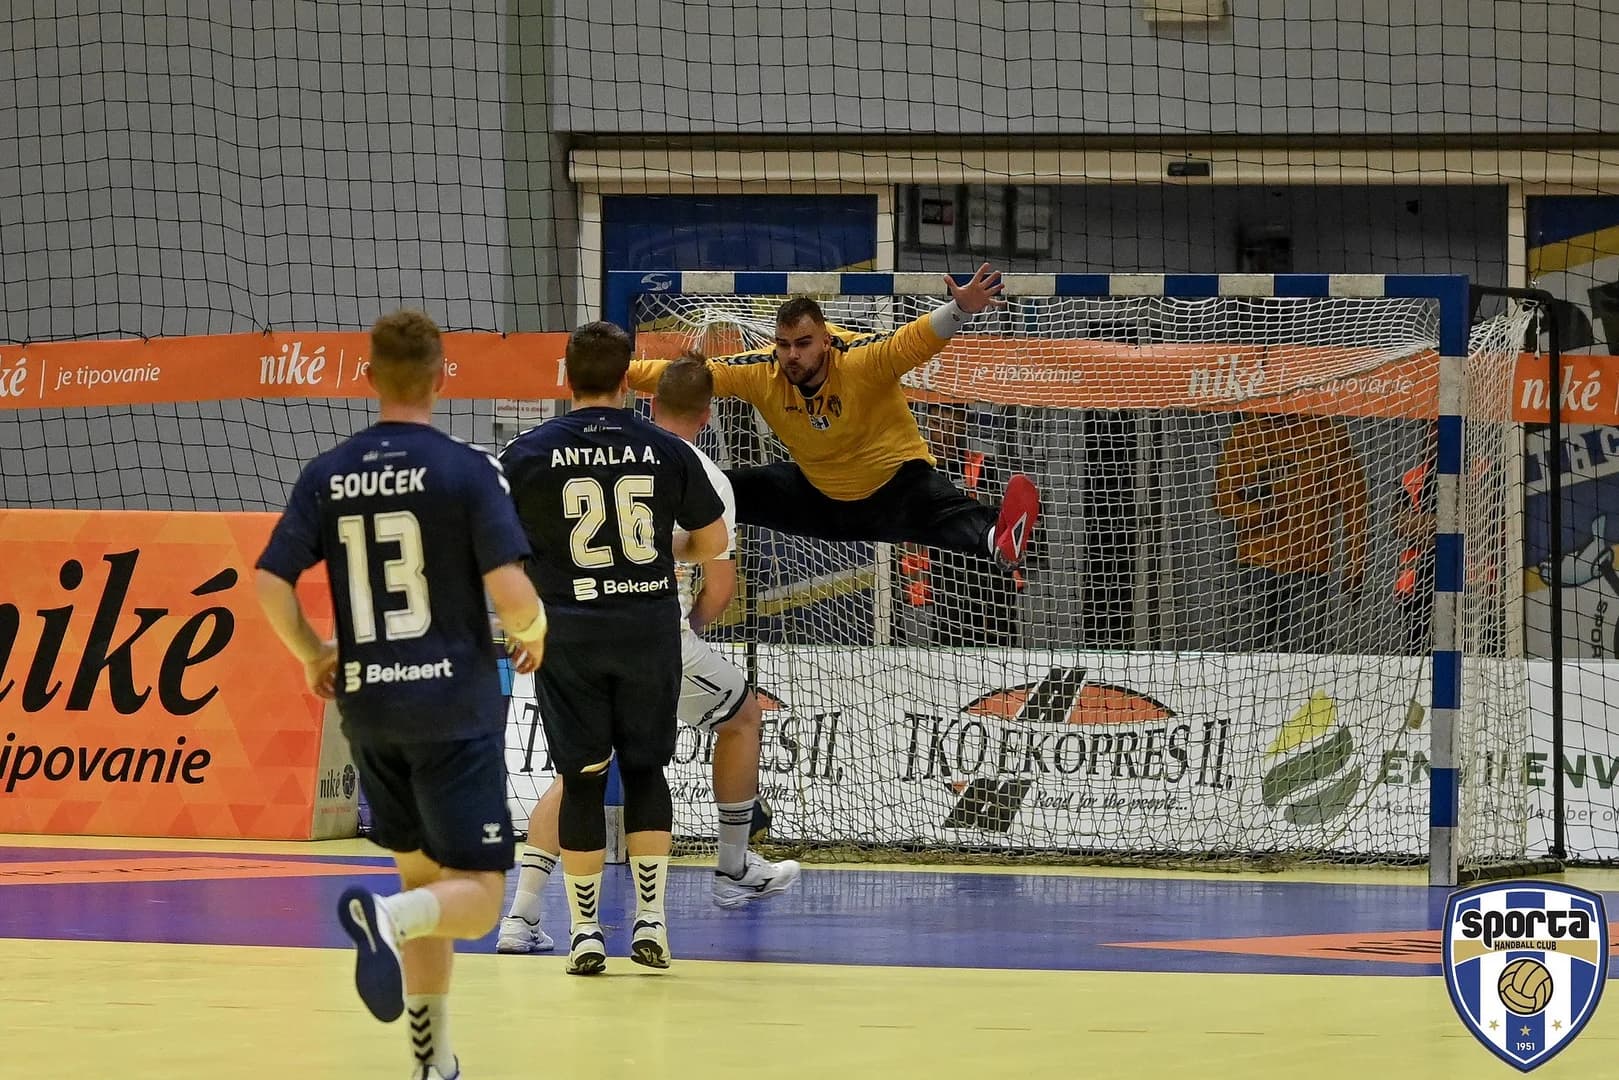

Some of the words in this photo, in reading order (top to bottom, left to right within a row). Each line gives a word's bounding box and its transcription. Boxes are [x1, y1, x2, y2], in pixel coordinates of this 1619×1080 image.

[54, 367, 73, 390] je
[76, 363, 161, 389] tipovanie
[259, 341, 327, 385] niké
[1187, 355, 1266, 400] niké
[1520, 365, 1601, 412] nké
[551, 446, 636, 468] ANTALA
[641, 446, 661, 465] A.
[330, 465, 427, 500] SOUČEK
[562, 475, 658, 568] 26
[337, 510, 431, 644] 13
[603, 576, 669, 595] Bekaert
[366, 658, 453, 684] Bekaert
[0, 732, 211, 793] ipovanie
